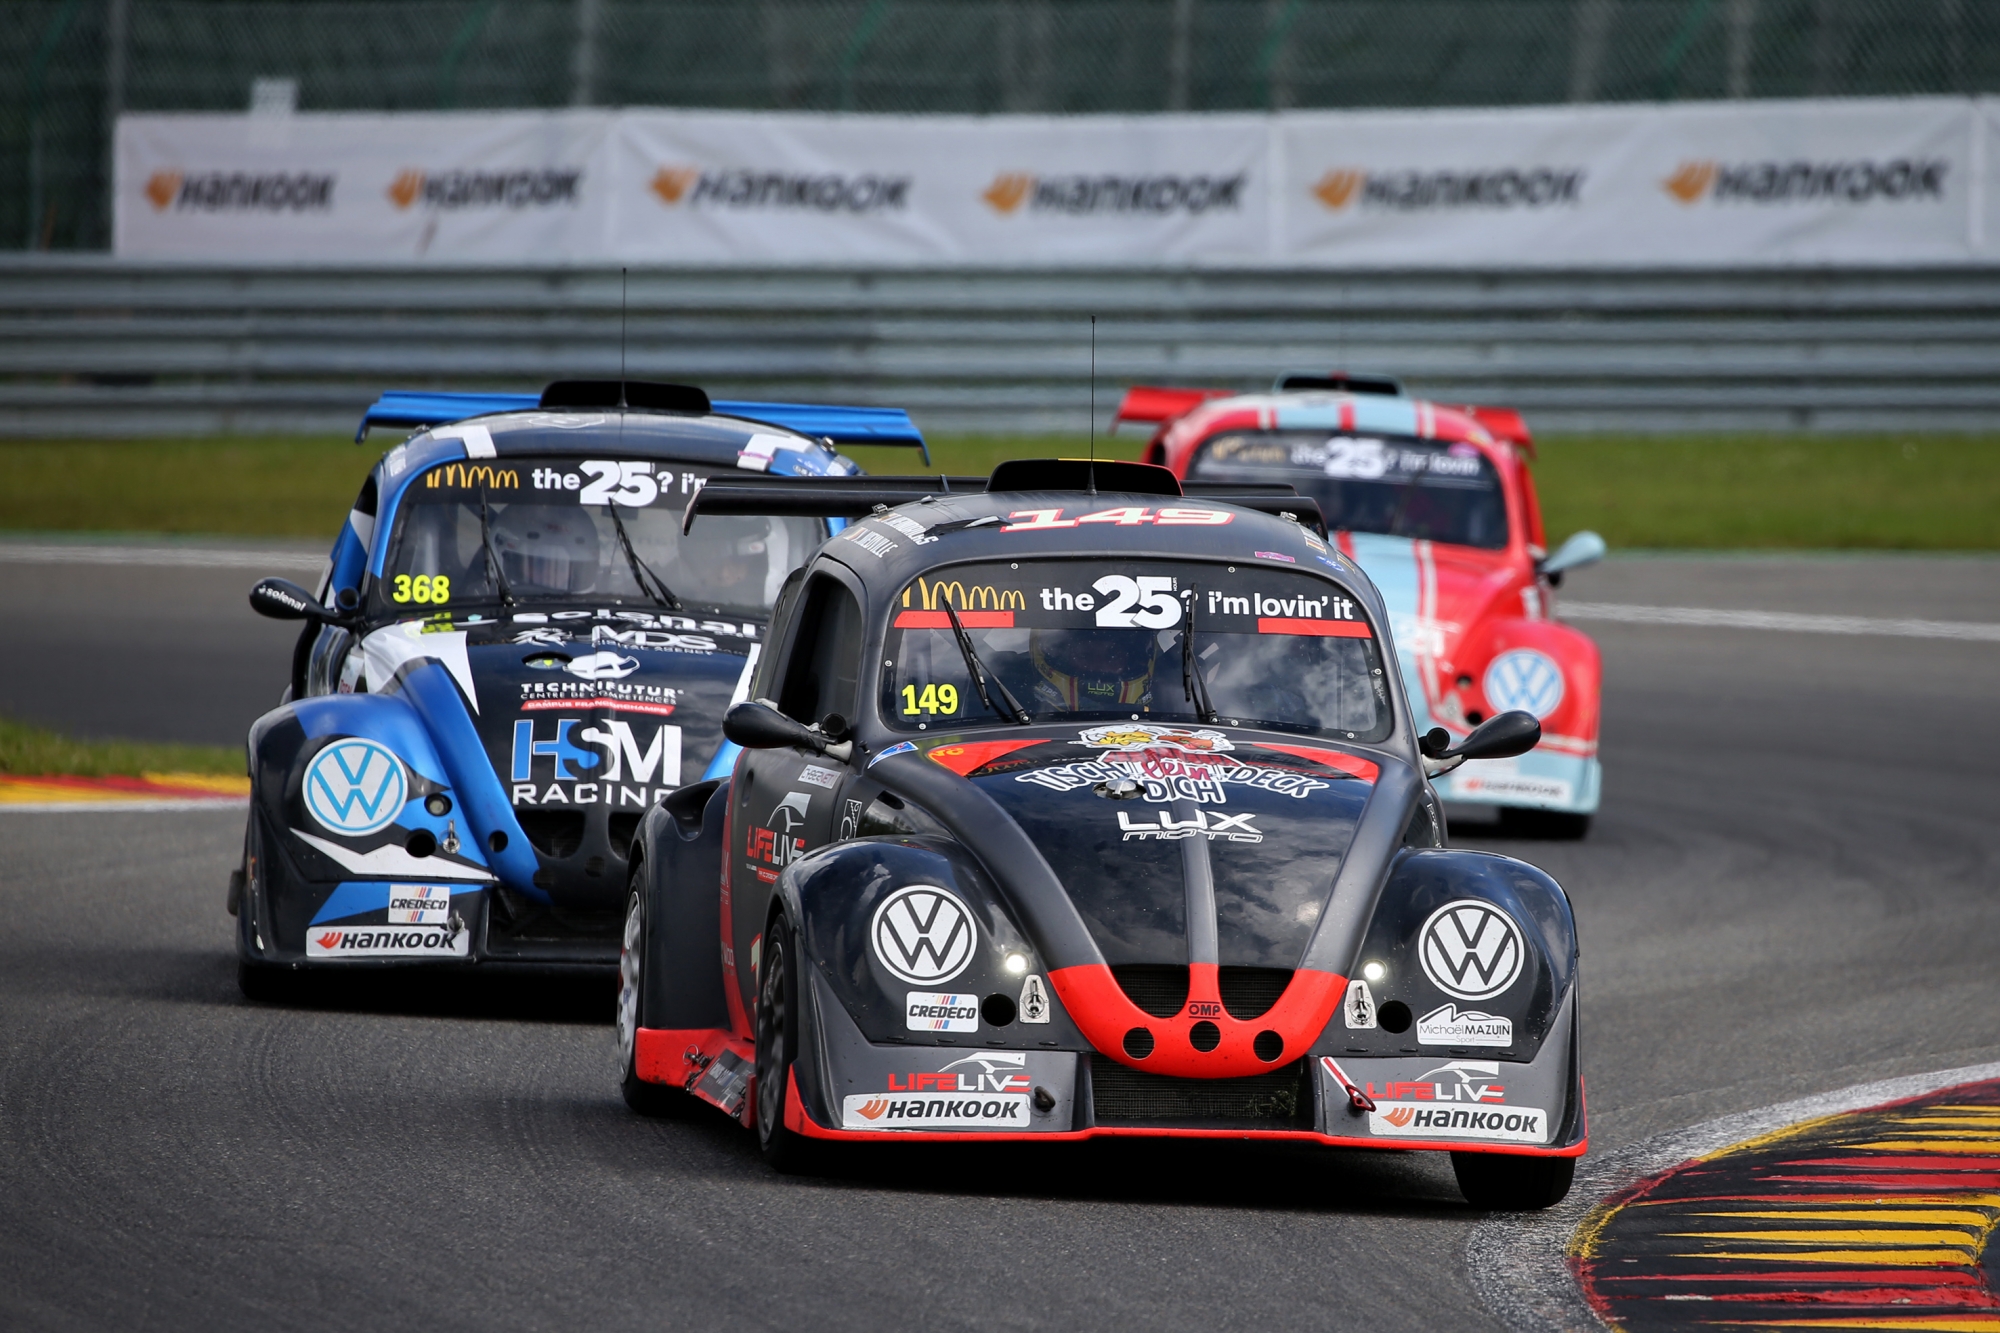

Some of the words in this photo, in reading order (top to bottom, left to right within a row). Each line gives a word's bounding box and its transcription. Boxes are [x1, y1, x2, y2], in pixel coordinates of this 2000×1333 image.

[532, 468, 581, 490] the
[1000, 507, 1236, 533] 149
[265, 587, 308, 612] solenal
[392, 574, 450, 604] 368
[1039, 587, 1095, 612] the
[1208, 590, 1251, 616] i'm
[1253, 592, 1328, 618] lovin'
[1333, 596, 1354, 620] it
[901, 683, 959, 715] 149
[511, 718, 682, 786] HSM
[1142, 776, 1227, 804] DICH
[1222, 764, 1330, 798] DECK
[1117, 809, 1263, 834] LUX
[390, 898, 448, 910] CREDECO
[908, 1004, 977, 1020] CREDECO
[1188, 1003, 1221, 1017] OMP
[1455, 1035, 1475, 1044] Sport
[887, 1073, 1032, 1093] LIFELIVE
[1366, 1082, 1506, 1103] LIFELIVE
